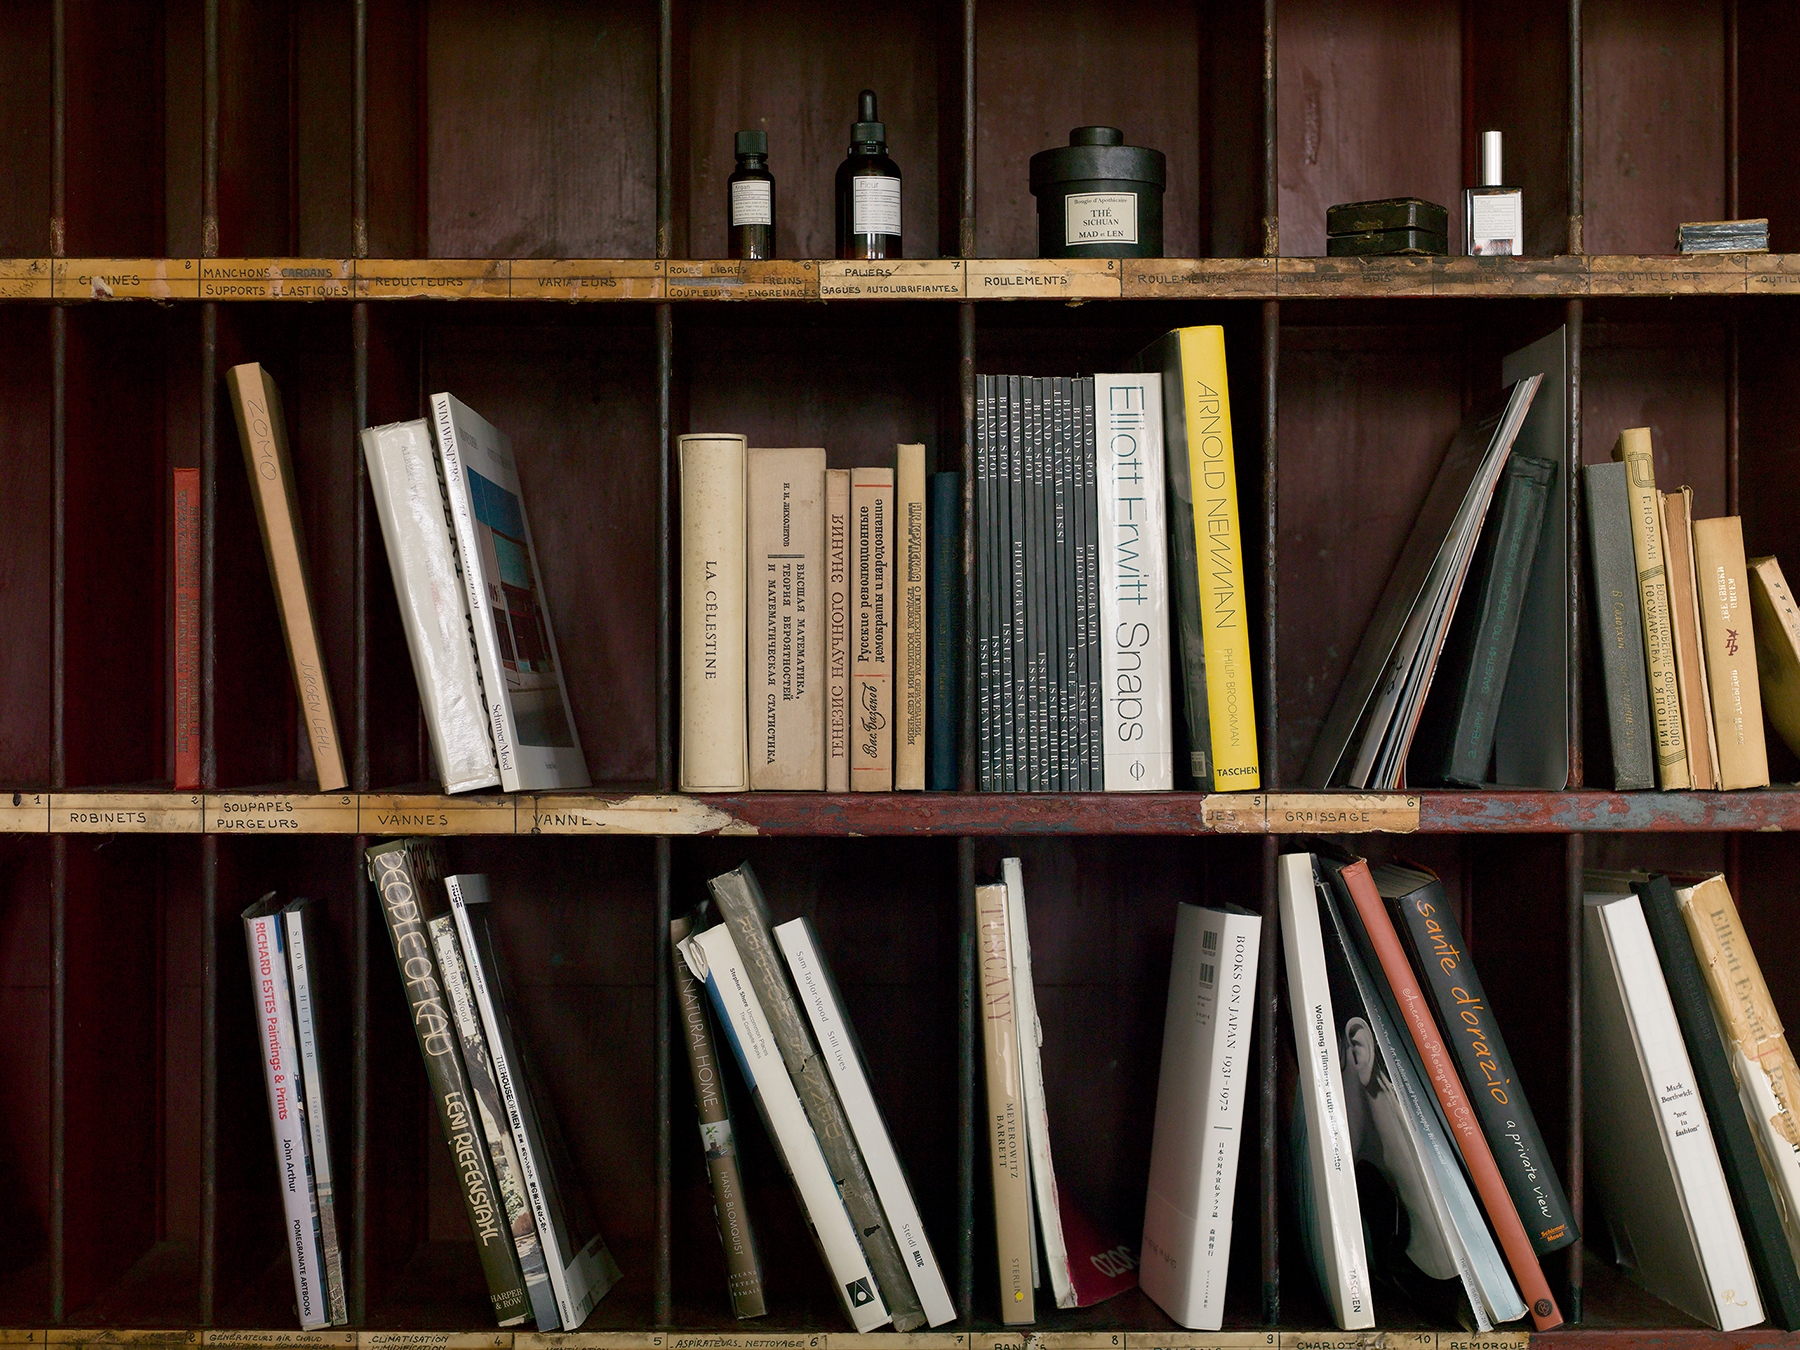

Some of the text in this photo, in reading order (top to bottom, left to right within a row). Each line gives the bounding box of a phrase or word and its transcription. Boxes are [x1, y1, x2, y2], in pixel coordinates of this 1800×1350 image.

[1083, 219, 1119, 227] SICHUAN
[1090, 207, 1112, 218] THÉ
[1078, 230, 1099, 238] MAD
[203, 268, 333, 278] MANCHONS CARDANS
[375, 276, 464, 287] REDUCTEURS
[538, 276, 617, 288] VARIATEURS
[710, 265, 747, 275] LIBRES
[984, 275, 1069, 287] ROULEMENTS
[1617, 271, 1702, 282] OUTILLAGE
[205, 284, 266, 296] SUPPORTS
[669, 288, 818, 298] COUPLEURS ENGRENAGES
[821, 284, 959, 294] BAGUES AUTOLUBRIFIANTES
[438, 399, 449, 426] WIM
[989, 445, 997, 480] SPOT
[1000, 445, 1008, 479] SPOT
[1013, 450, 1021, 485] SPOT
[1025, 446, 1033, 480] SPOT
[1034, 452, 1043, 487] SPOT
[1044, 447, 1052, 482] SPOT
[1064, 447, 1072, 482] SPOT
[1196, 379, 1237, 630] ARNOLD NEWMAN
[1644, 507, 1657, 560] НОРМАН
[1109, 384, 1149, 743] Elliott Erwitt Snaps
[858, 506, 872, 663] Русские революционные
[874, 499, 885, 664] демократы народознание
[1073, 407, 1088, 765] BLIND SPOT PHOTOGRAPHY ISSUE NINE
[1085, 404, 1099, 772] BLIND SPOT PHOTOGRAPHY ISSUE EIGHT
[705, 560, 718, 680] LA CÉLESTINE
[783, 563, 794, 700] ТЕОРИЯ ВЕРОЯТНОСТЕЙ
[795, 563, 805, 700] ВЫСШАЯ МАТЕМАТИКА,
[832, 513, 844, 758] ГЕНЕЗИС НАУЧНОГО ЗНАНИЯ
[767, 580, 775, 765] МАТЕМАТИЧЕСКАЯ СТАТИСТИКА
[1068, 646, 1076, 687] ISSUE
[1646, 585, 1669, 748] ГОСУДАРСТВА ЯПОНИИ
[1223, 647, 1241, 747] PHILIP BROOKMAN
[1664, 671, 1681, 747] СОВРЕМЕННОГО
[313, 716, 327, 757] LEHL
[492, 703, 513, 772] Schirmer/Mosel
[1069, 695, 1077, 749] TWENTY
[1215, 765, 1258, 779] TASCHEN
[70, 811, 147, 823] ROBINETS
[191, 796, 199, 805] 2
[223, 802, 293, 812] SOUPAPES
[341, 796, 351, 805] 3
[1253, 796, 1261, 806] 5
[1285, 811, 1371, 823] GRAISSAGE
[1406, 796, 1415, 807] 6
[216, 819, 299, 829] PURGEURS
[377, 815, 448, 826] VANNES
[370, 849, 458, 1059] PEOPLE OF KAU
[980, 903, 1011, 1026] TUSCANY
[443, 949, 471, 1024] Sam Taylor-Wood
[1225, 935, 1246, 1049] BOOKS ON JAPAN
[1709, 908, 1746, 973] Elliott
[1733, 976, 1771, 1045] Erwitt
[292, 930, 313, 1059] SLOW SHUTTER
[728, 967, 764, 1039] Stephen Uncommon
[795, 950, 849, 1072] Sam Taylor-Wood Still Lives
[255, 922, 290, 1120] RICHARD ESTES Paintings Prints
[1313, 1004, 1327, 1047] Wolfgang
[680, 978, 720, 1113] NATURAL HOME.
[1414, 892, 1556, 1220] sante d'orazio private view
[996, 1115, 1007, 1169] BARRETT
[1006, 1103, 1018, 1179] MEYEROWITZ
[283, 1138, 298, 1193] John Arthur
[442, 1091, 504, 1247] LENI RIEFENSTAHL
[719, 1171, 744, 1257] HANS BLOMQUIST
[901, 1222, 917, 1248] Steidl
[292, 1219, 312, 1317] POMEGRANATE ARTBOOKS
[490, 1287, 523, 1303] HARPER
[1347, 1268, 1363, 1313] TASCHEN
[209, 1331, 274, 1342] GÉNÉRATEURS
[295, 1332, 323, 1342] CHAUD
[345, 1333, 353, 1342] 3
[494, 1336, 503, 1346] 4
[653, 1337, 662, 1345] 5
[675, 1335, 804, 1348] ASPIRATEURS NETTOYAGE
[810, 1336, 818, 1346] 6
[956, 1335, 964, 1345] 7
[1112, 1335, 1119, 1345] 8
[1266, 1334, 1274, 1344] 9
[1414, 1334, 1431, 1344] 10
